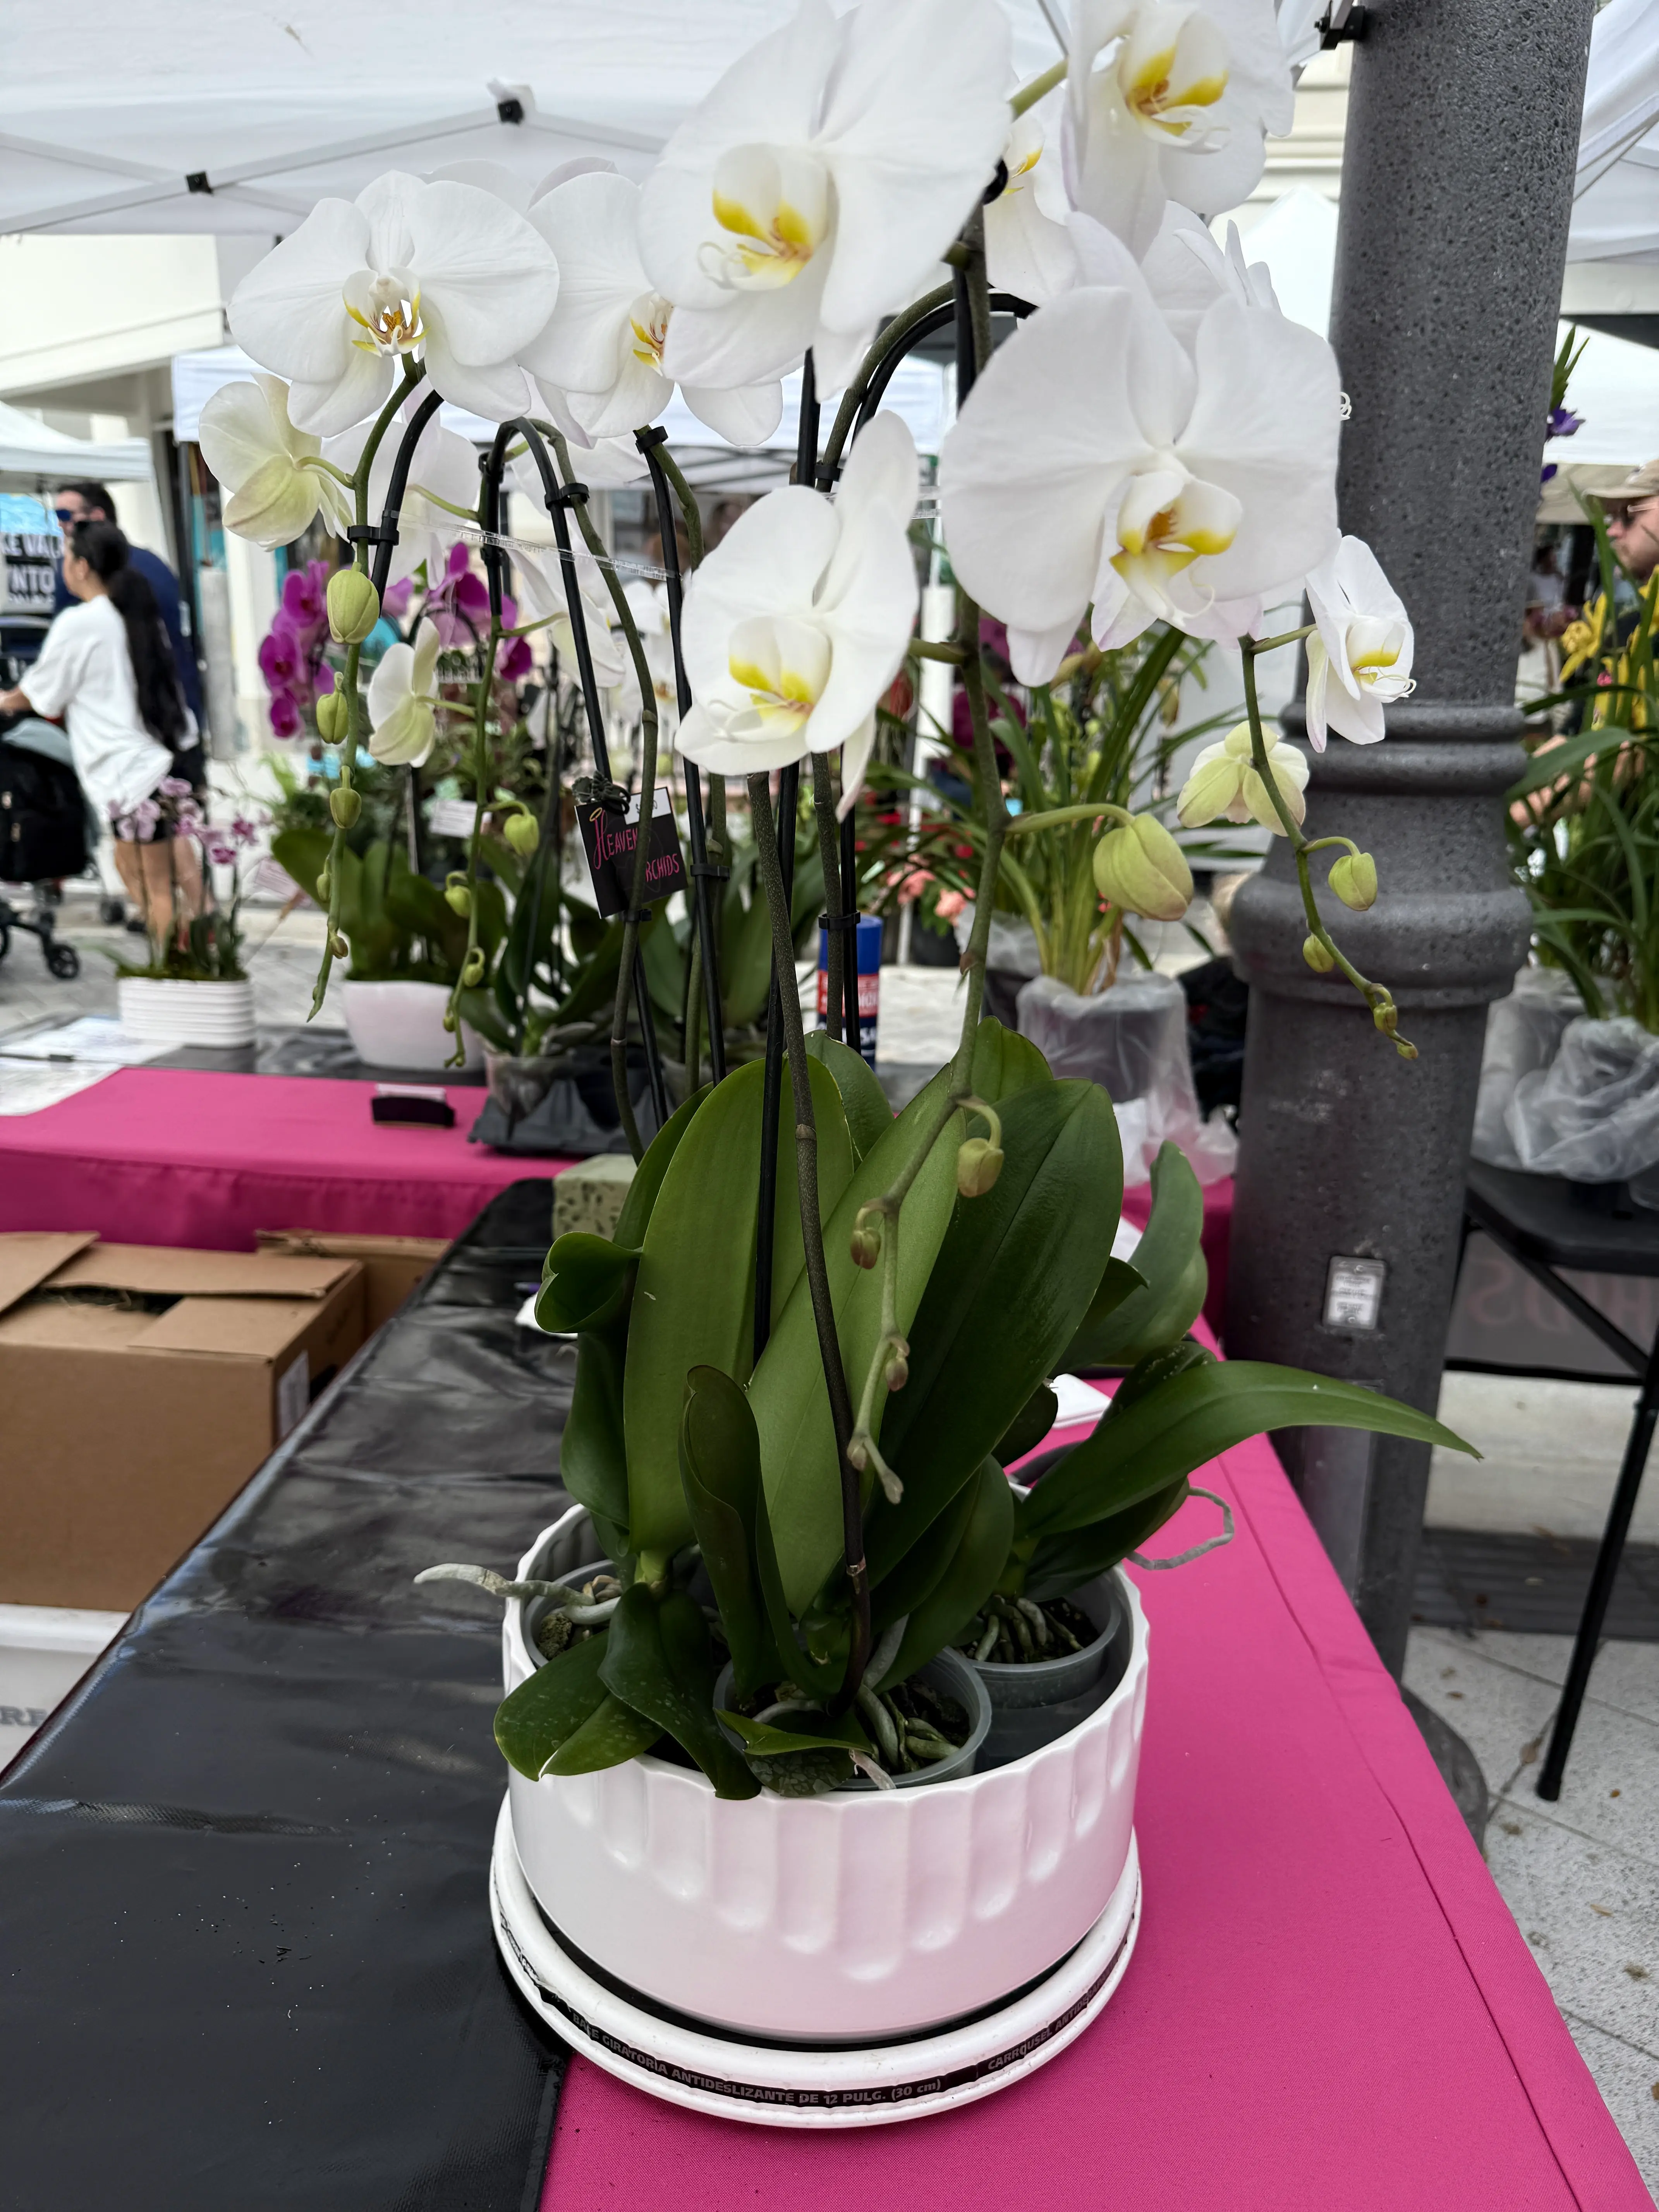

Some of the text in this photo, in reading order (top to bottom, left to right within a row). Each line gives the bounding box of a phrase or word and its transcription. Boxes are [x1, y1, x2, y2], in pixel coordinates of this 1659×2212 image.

[646, 853, 680, 883] RCHIDS
[602, 2035, 668, 2075] GIRATORIA
[671, 2069, 794, 2102] ANTIDESLIZANTE
[799, 2093, 819, 2103] DE
[823, 2094, 838, 2104] 12
[843, 2091, 886, 2103] PULG.
[891, 2086, 912, 2101] (30
[917, 2079, 941, 2093] cm)
[988, 2027, 1053, 2070] CARROUSEL
